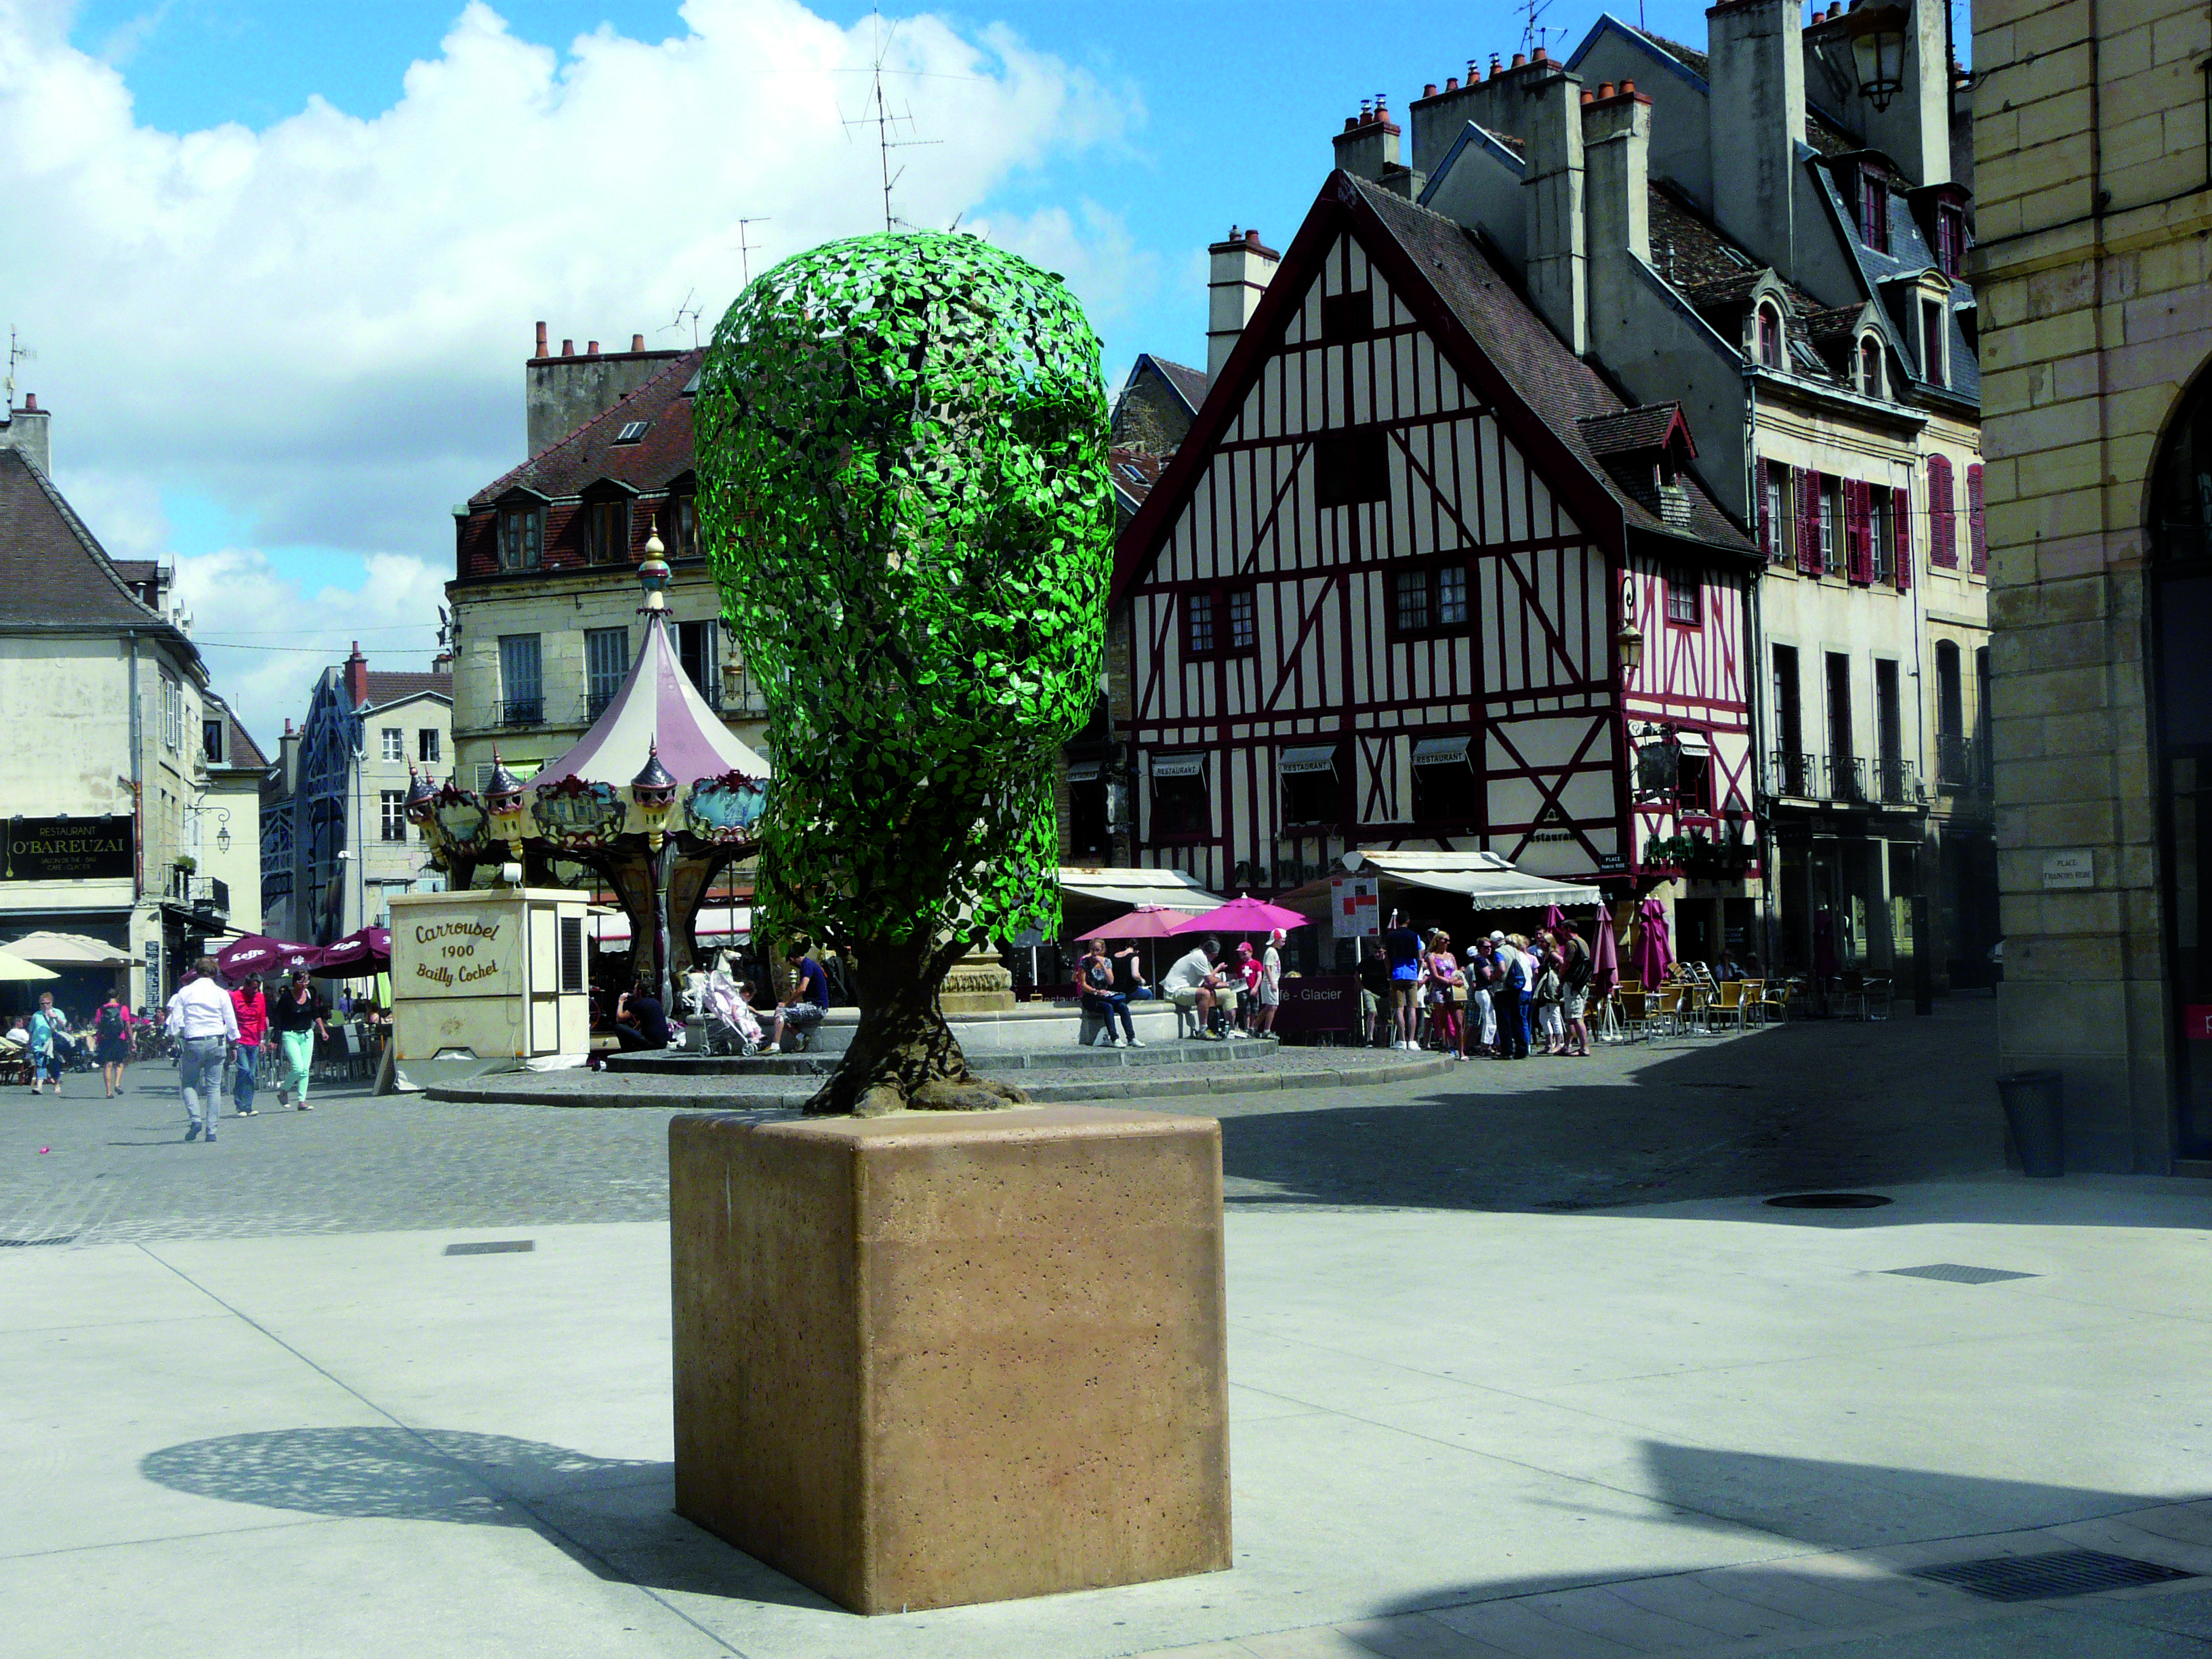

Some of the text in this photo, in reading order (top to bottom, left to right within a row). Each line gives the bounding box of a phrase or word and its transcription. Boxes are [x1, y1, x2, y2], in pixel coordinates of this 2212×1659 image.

[1416, 753, 1462, 763] RESTAURANT
[1157, 766, 1195, 774] RESTAURANT
[1284, 761, 1327, 771] RESTAURANT
[40, 826, 96, 836] RESTAURANT
[13, 838, 124, 854] O'BAREUZAI
[415, 922, 500, 943] Carrousel
[230, 949, 266, 962] Leffe
[442, 945, 474, 958] 1900
[416, 959, 499, 987] Bailly Cochet
[1301, 989, 1342, 1000] Glacier
